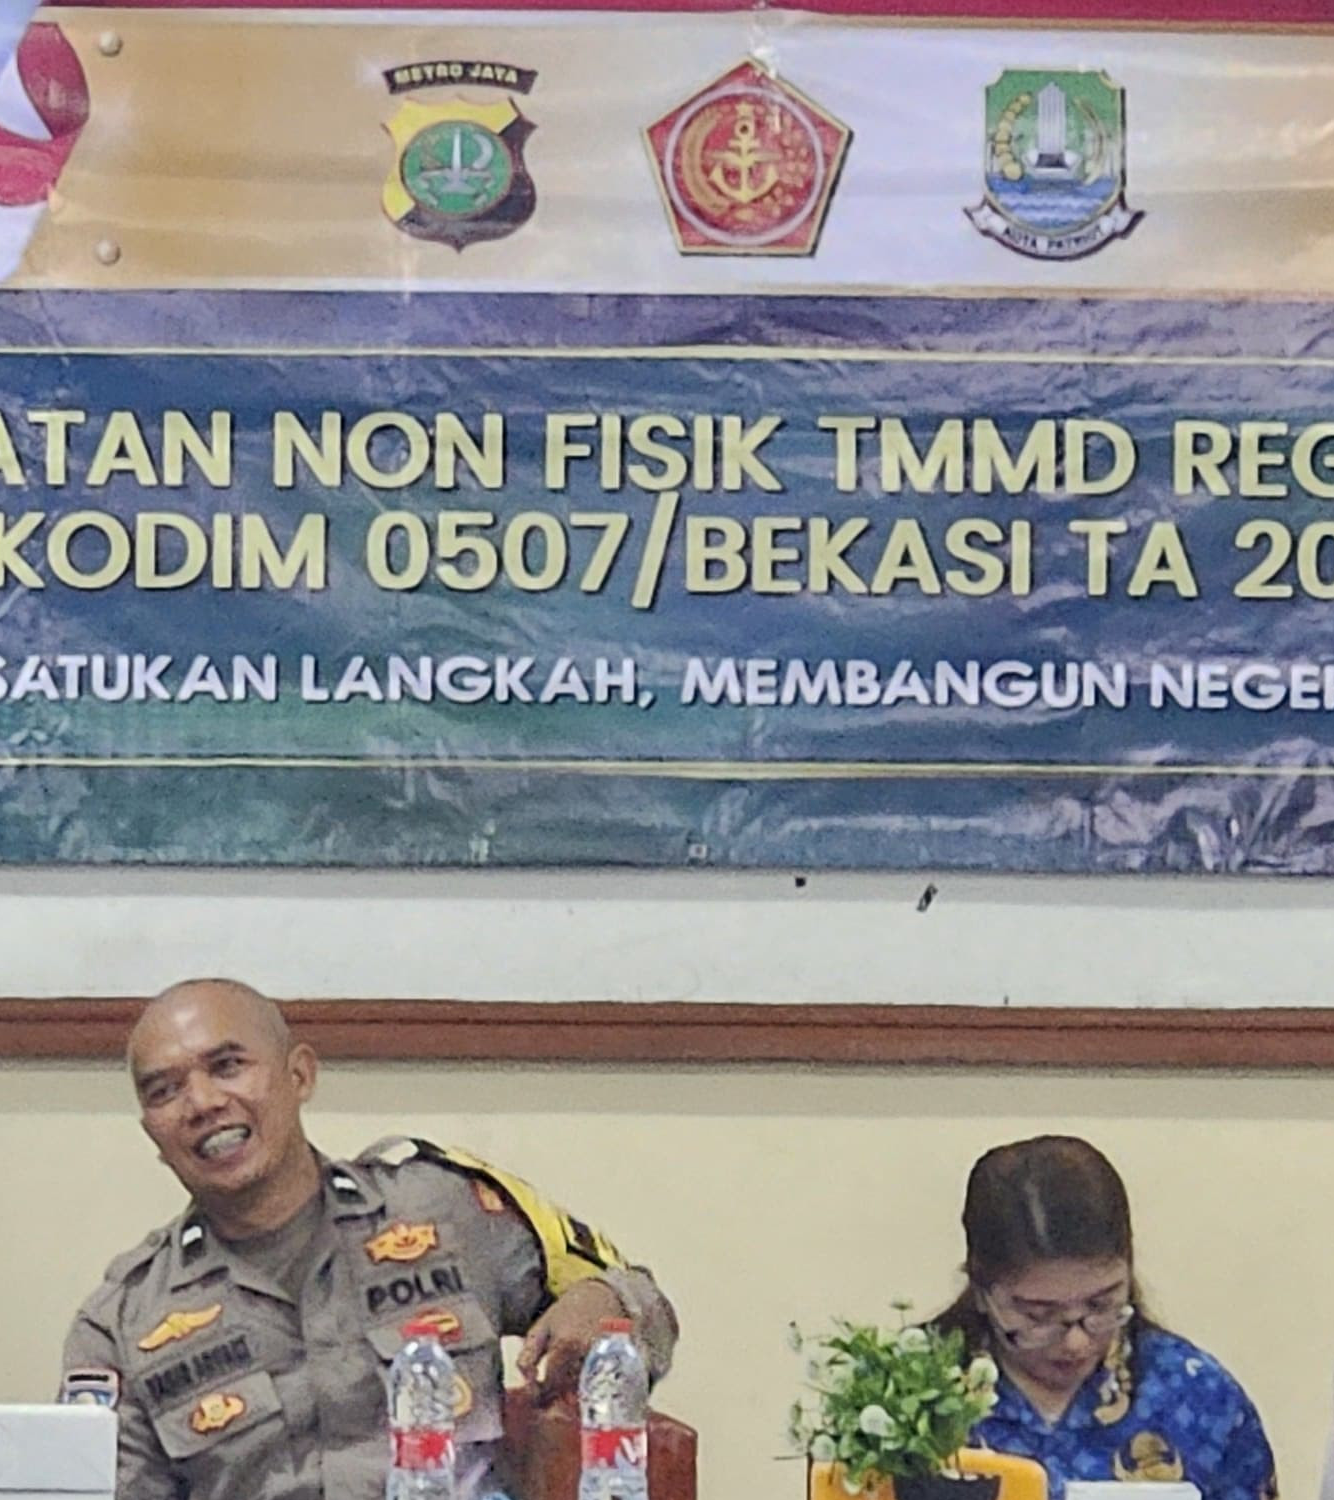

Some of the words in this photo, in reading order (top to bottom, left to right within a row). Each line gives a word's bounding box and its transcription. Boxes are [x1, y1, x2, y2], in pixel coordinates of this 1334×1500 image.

[394, 63, 463, 84] METRO
[470, 63, 517, 83] JAYA
[275, 415, 503, 486] NON
[547, 415, 781, 489] FISIK
[822, 417, 1134, 492] TMMD
[369, 493, 1030, 608] 0507/BEKASI
[1071, 522, 1195, 594] TA
[302, 656, 653, 711] LANGKAH,
[681, 658, 1127, 708] MEMBANGUN
[366, 1265, 465, 1313] POLRI
